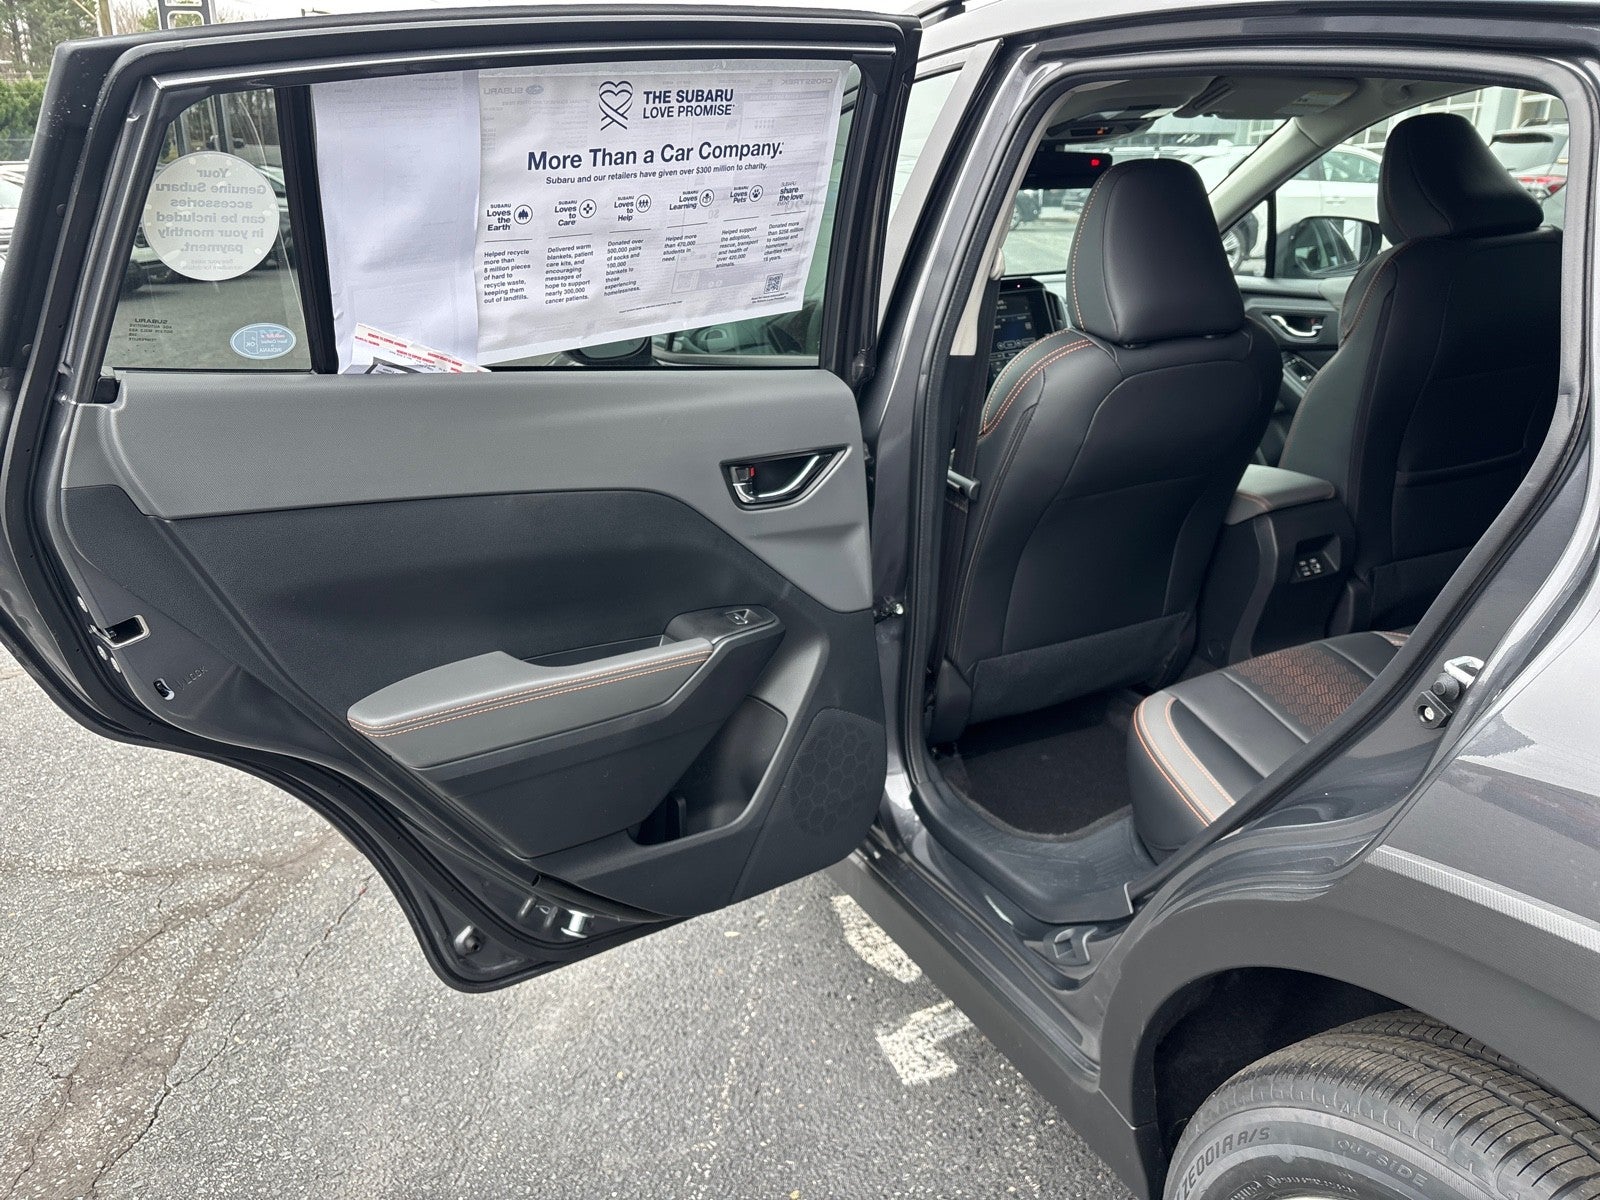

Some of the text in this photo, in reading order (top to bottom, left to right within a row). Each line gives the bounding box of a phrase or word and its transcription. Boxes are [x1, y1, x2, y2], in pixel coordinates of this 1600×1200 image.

[644, 89, 734, 104] THE SUBARU
[643, 104, 733, 119] LOVE PROMISE
[528, 151, 582, 170] More
[589, 148, 636, 167] Than
[644, 150, 654, 163] a
[661, 144, 693, 162] Car
[608, 171, 637, 180] retailers
[659, 169, 677, 178] given
[713, 164, 734, 172] million
[780, 186, 799, 194] share
[507, 249, 529, 257] recycle
[604, 286, 640, 296] homelessness.
[605, 280, 637, 289] experiencing
[1237, 1127, 1270, 1146] A/S
[1337, 1139, 1428, 1188] OUTSIDE
